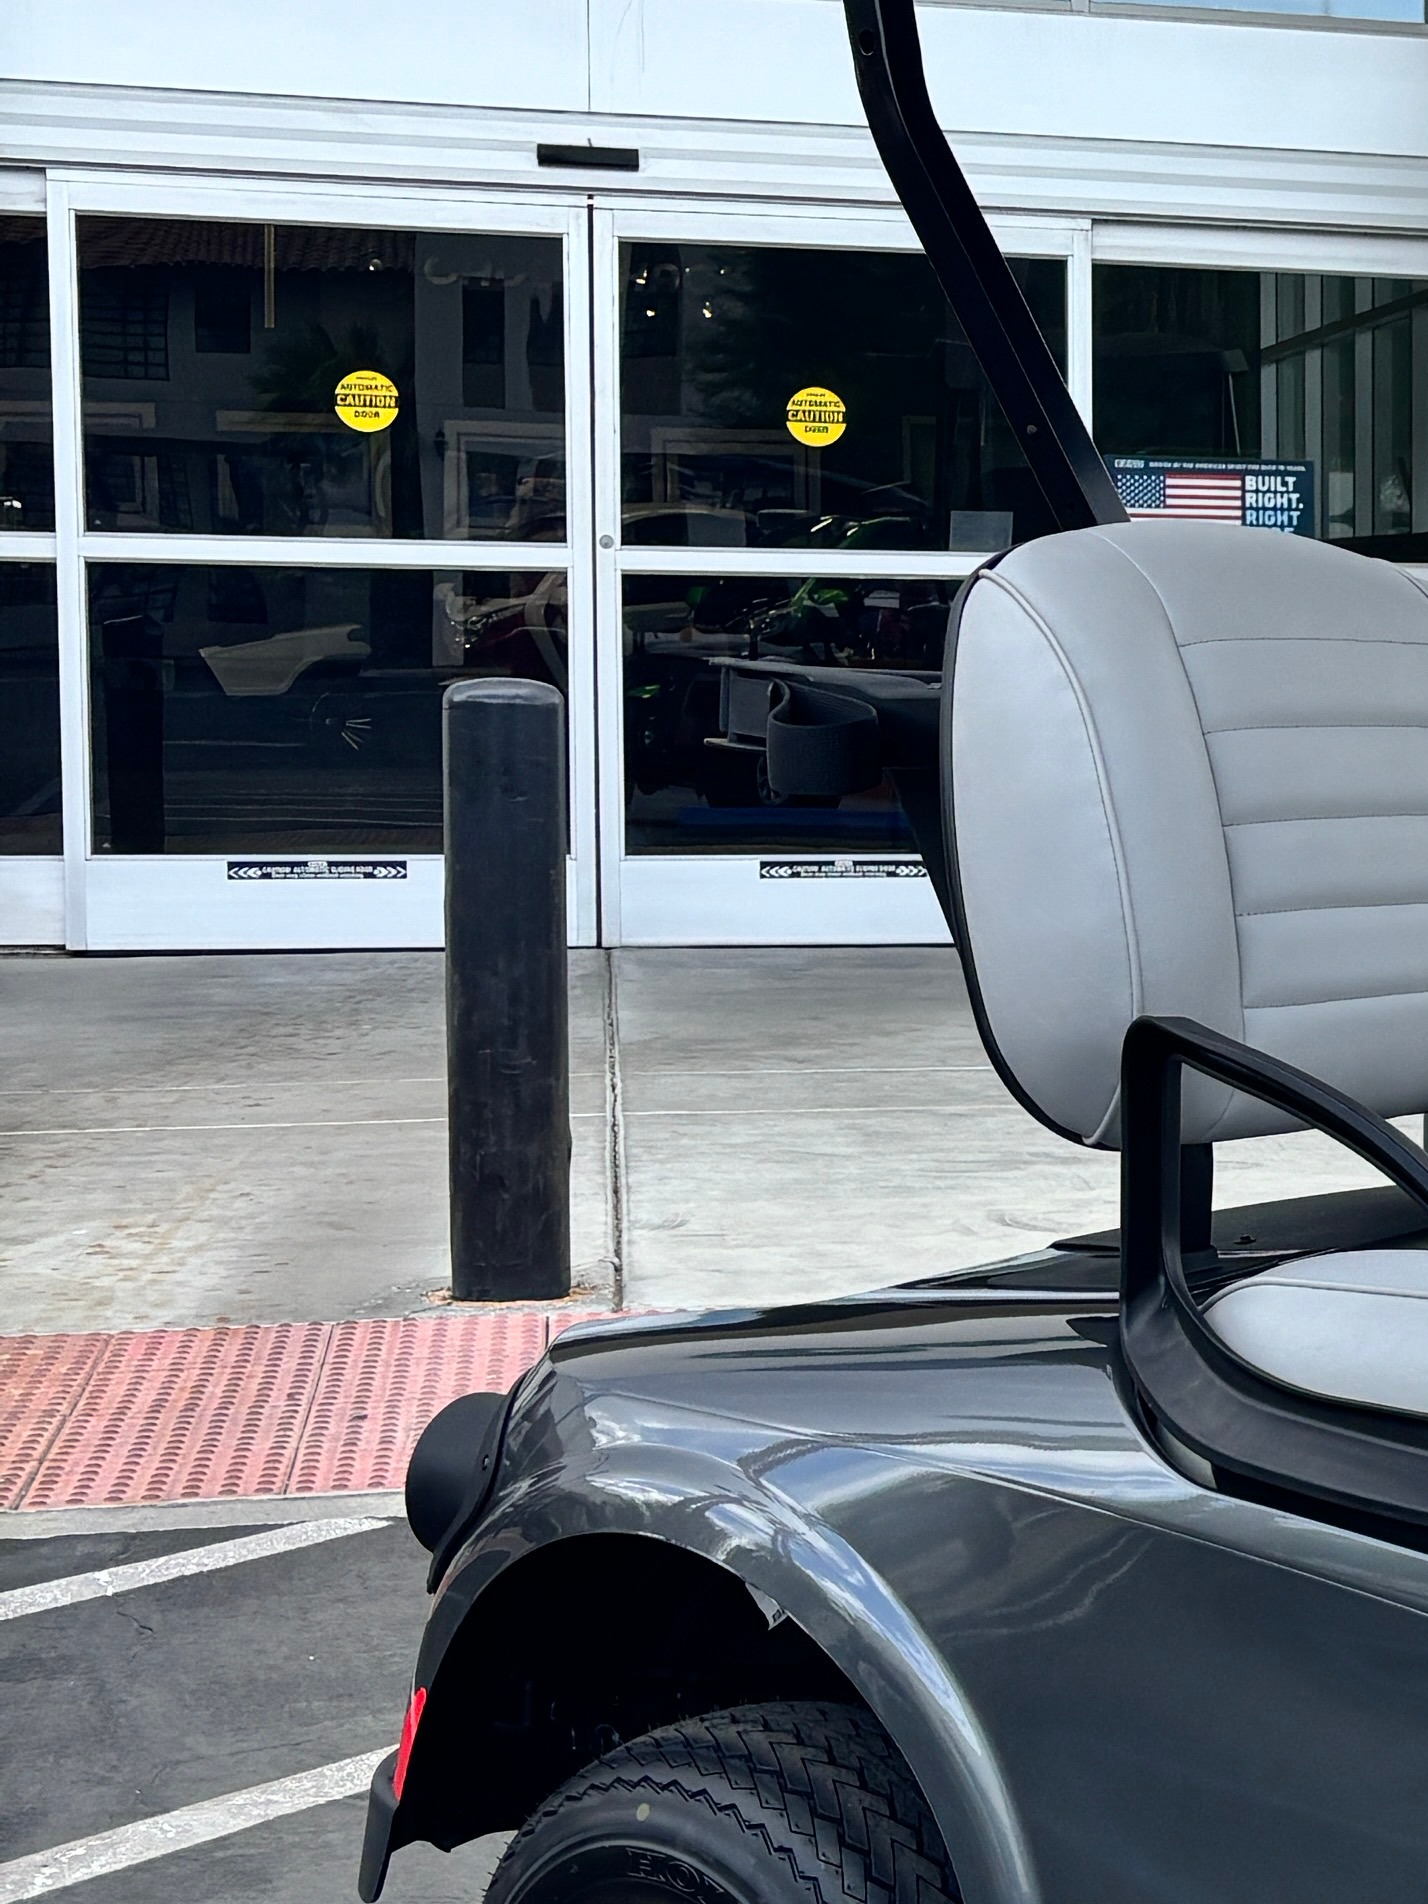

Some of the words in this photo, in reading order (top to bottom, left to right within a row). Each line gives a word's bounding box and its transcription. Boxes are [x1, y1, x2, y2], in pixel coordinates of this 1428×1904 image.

[336, 393, 396, 407] CAUTION
[788, 410, 844, 423] CAUTION
[1245, 475, 1297, 492] BUILT
[1245, 492, 1304, 509] RIGHT.
[1246, 509, 1301, 526] RIGHT
